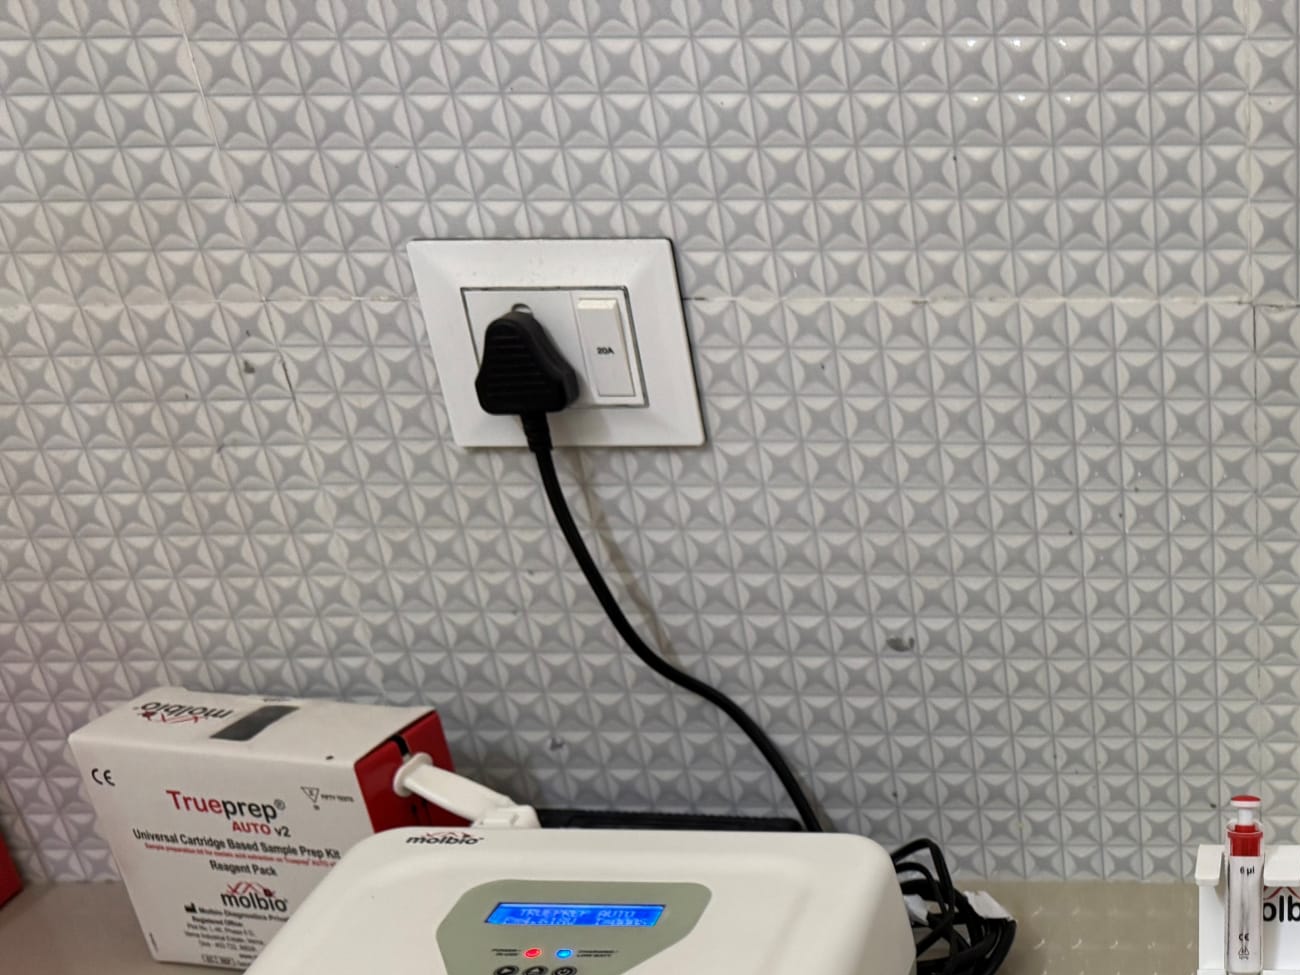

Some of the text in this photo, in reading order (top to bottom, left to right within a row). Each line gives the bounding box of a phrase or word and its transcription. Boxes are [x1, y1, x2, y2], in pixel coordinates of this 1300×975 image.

[232, 820, 291, 838] AUTO v2
[132, 828, 179, 844] Universal
[179, 833, 226, 850] Cartridge
[226, 838, 260, 852] Based
[260, 841, 298, 856] Sample
[298, 845, 325, 860] Prep
[324, 848, 342, 860] Kit
[209, 860, 252, 875] Reagent
[251, 863, 279, 877] Pack
